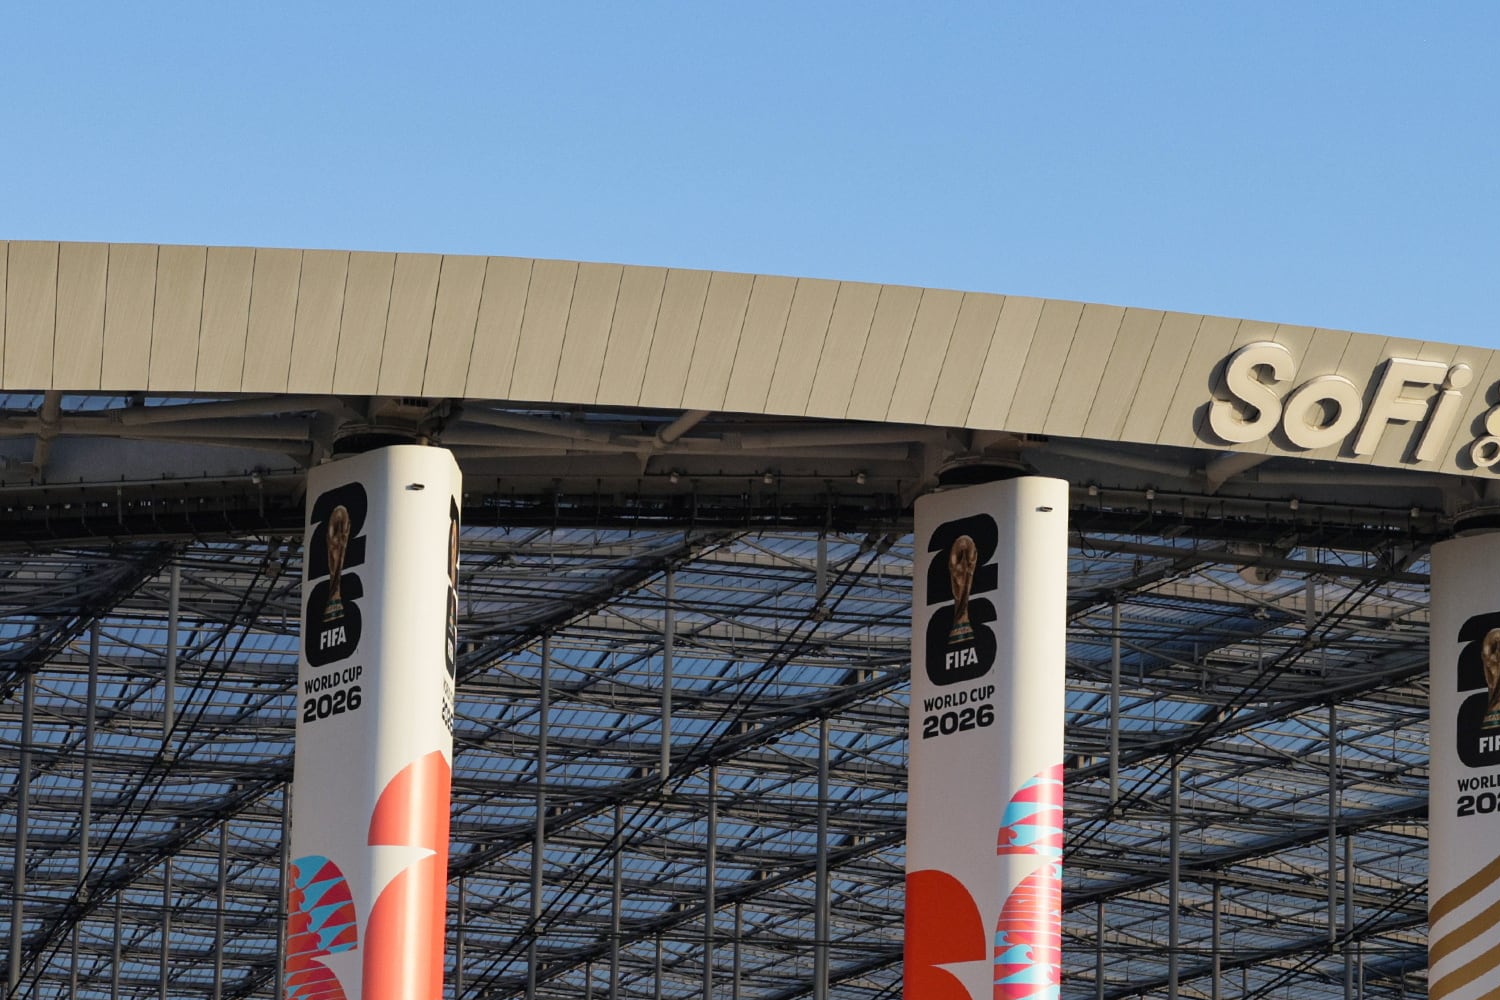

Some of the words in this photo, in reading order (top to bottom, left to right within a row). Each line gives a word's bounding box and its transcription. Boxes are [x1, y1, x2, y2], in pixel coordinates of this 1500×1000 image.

[1207, 341, 1473, 462] SoFi
[320, 626, 346, 650] FIFA
[945, 647, 979, 670] FIFA
[304, 672, 340, 694] WORLD
[342, 665, 363, 685] CUP
[303, 685, 362, 723] 2026
[924, 690, 968, 712] WORLD
[970, 684, 995, 702] CUP
[922, 703, 995, 739] 2026
